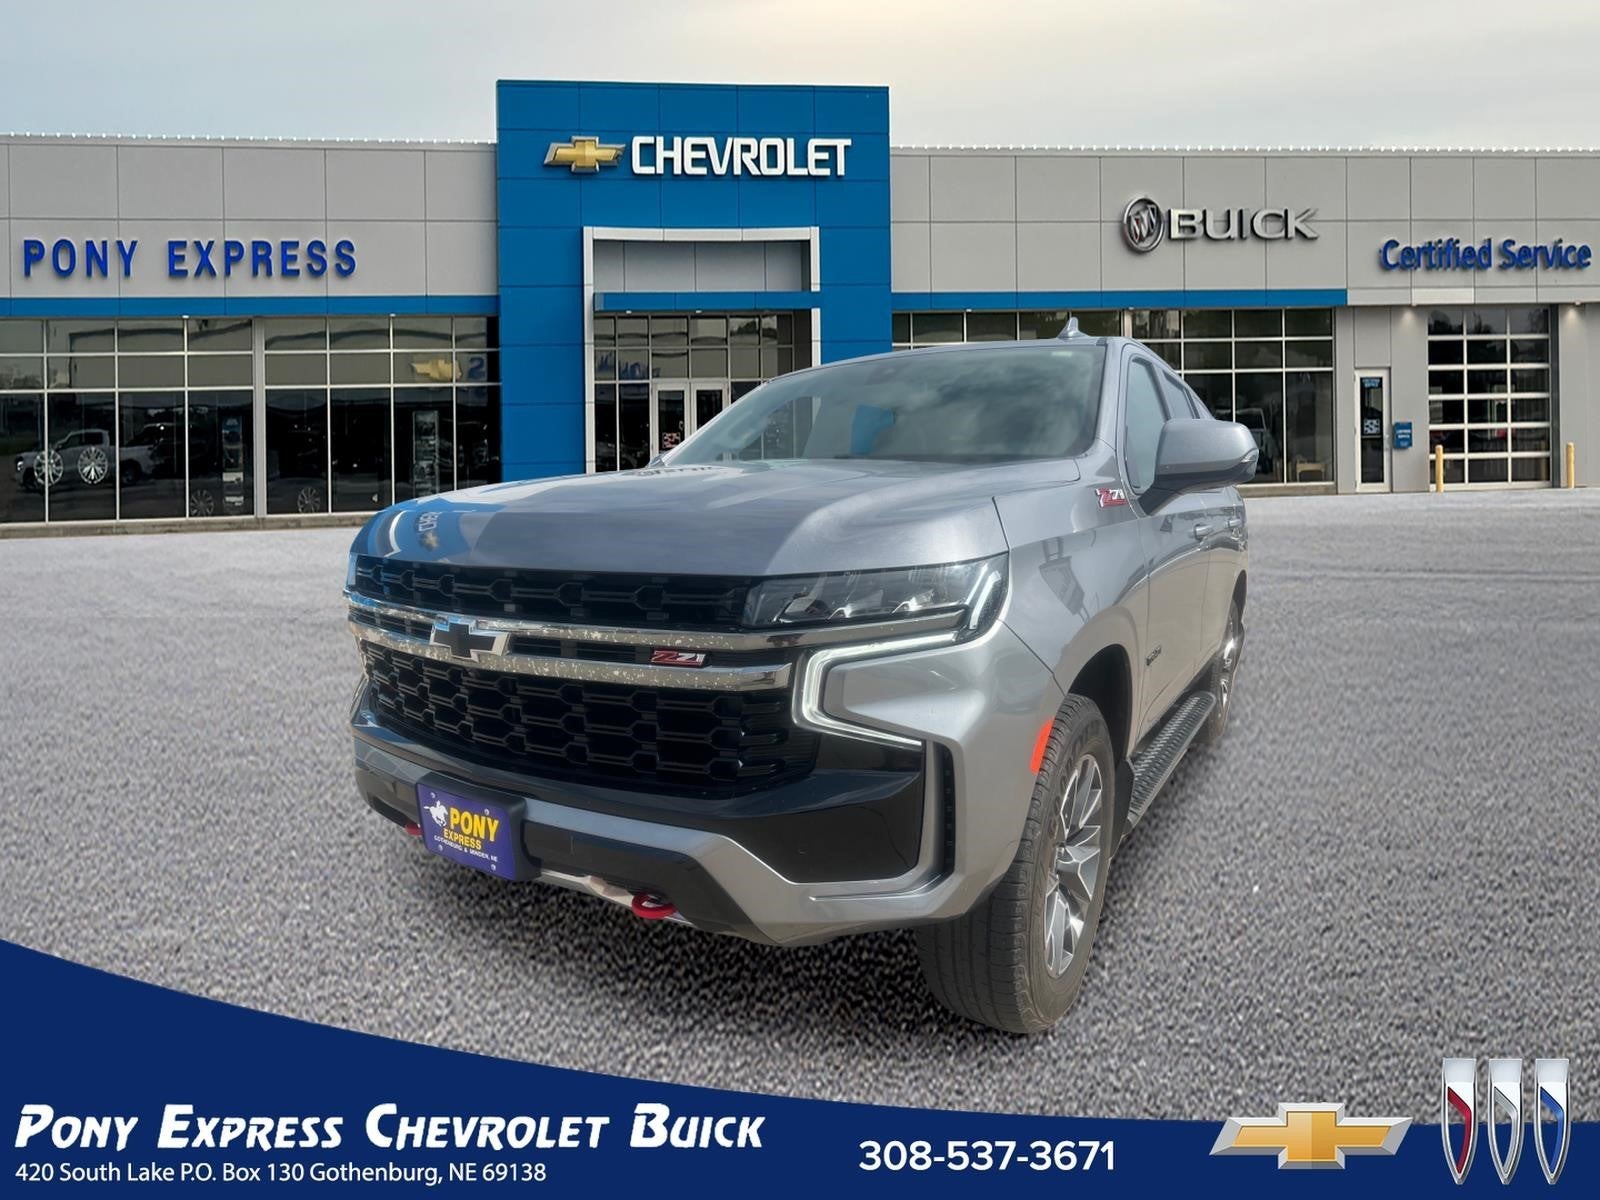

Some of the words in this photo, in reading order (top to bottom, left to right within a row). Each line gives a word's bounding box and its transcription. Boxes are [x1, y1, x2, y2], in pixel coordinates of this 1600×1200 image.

[631, 135, 852, 177] CHEVROLET
[1168, 208, 1319, 241] BUICK
[23, 239, 138, 278] PONY
[168, 240, 357, 278] EXPRESS
[1380, 238, 1493, 271] Certified
[1499, 238, 1592, 270] Service
[650, 650, 706, 667] Z71
[443, 829, 482, 850] EXPRESS
[449, 808, 497, 842] PONY
